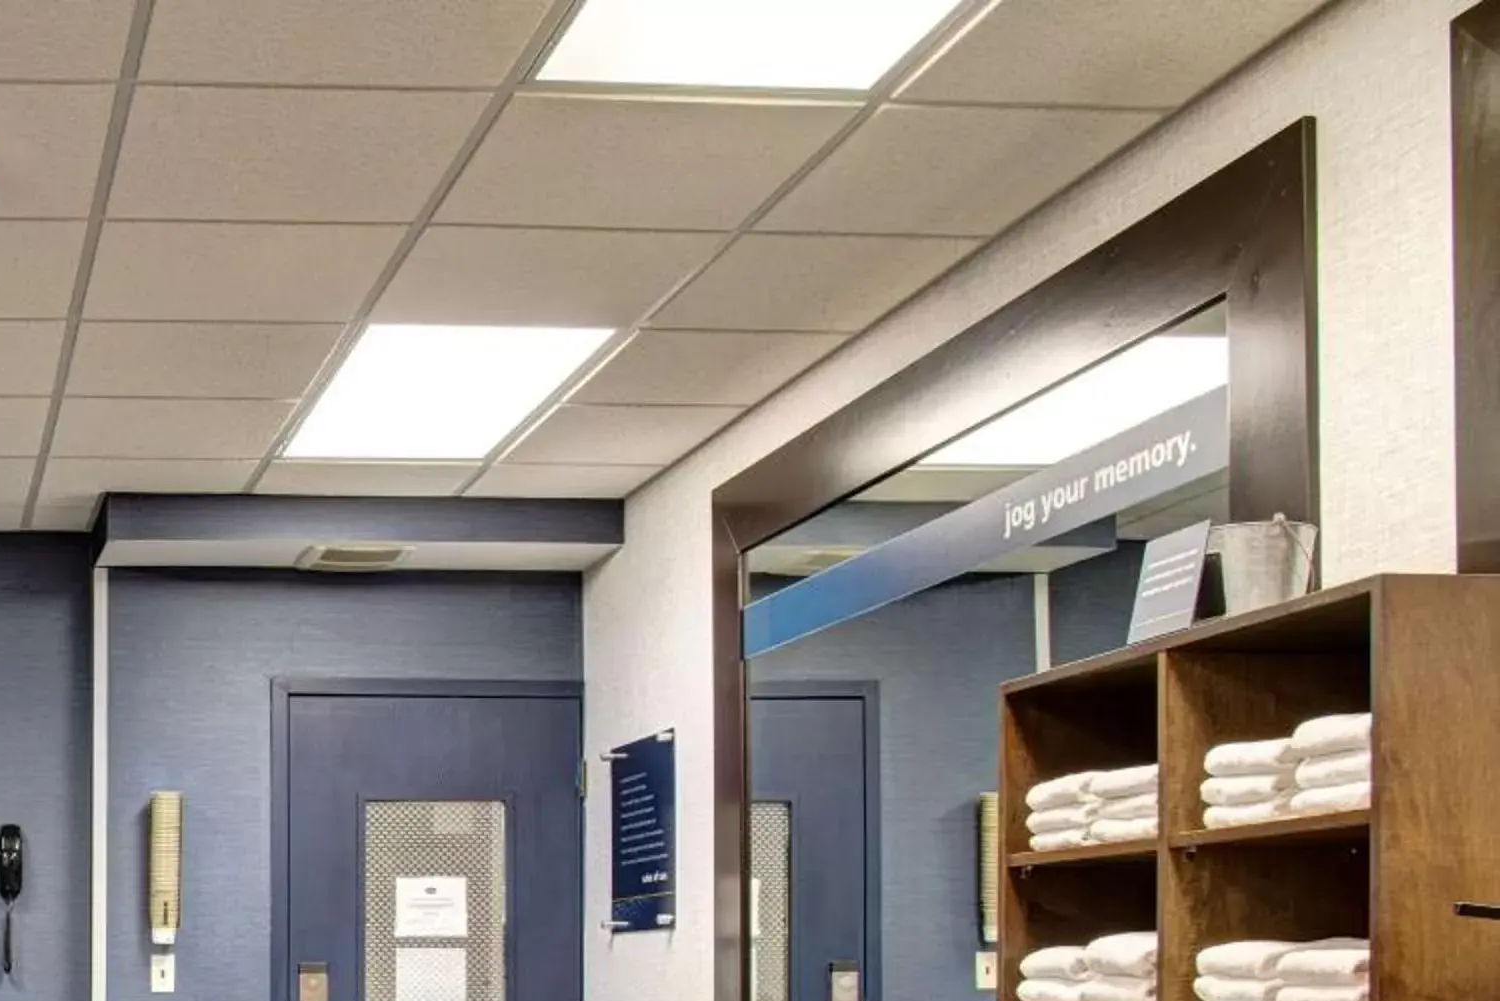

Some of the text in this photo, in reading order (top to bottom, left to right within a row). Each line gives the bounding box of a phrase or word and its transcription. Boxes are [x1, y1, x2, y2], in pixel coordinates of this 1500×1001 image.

[1003, 429, 1197, 539] jog your memory.
